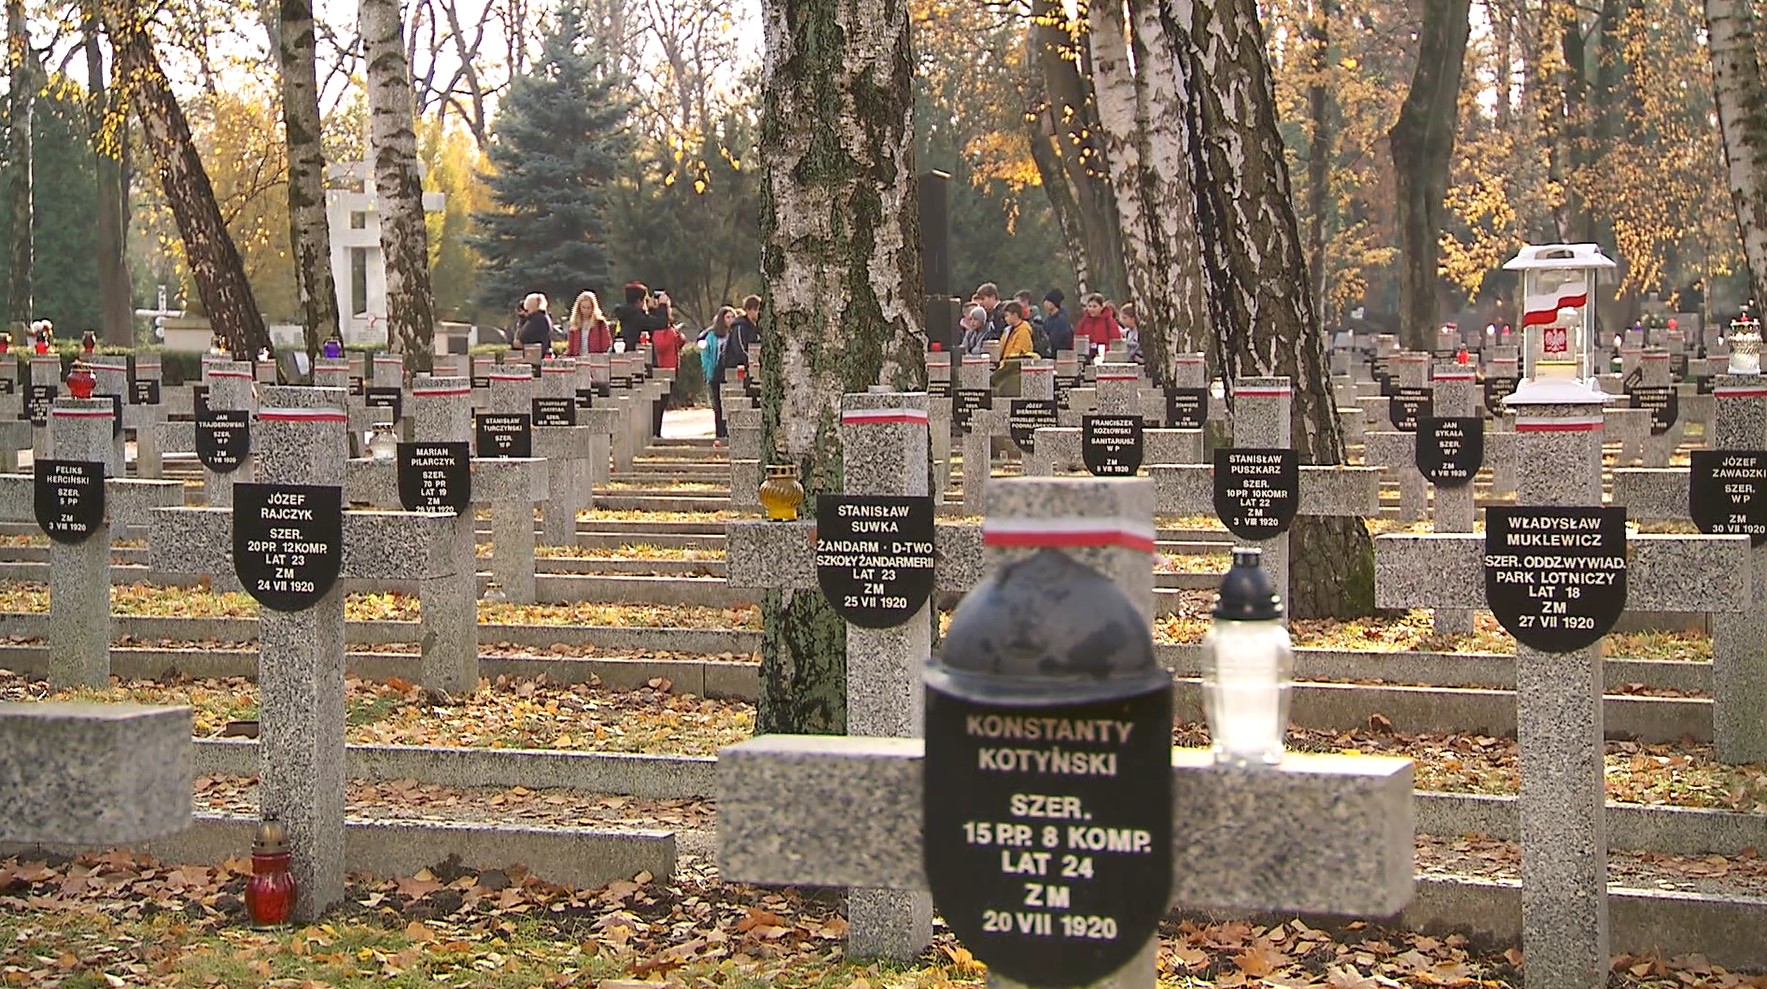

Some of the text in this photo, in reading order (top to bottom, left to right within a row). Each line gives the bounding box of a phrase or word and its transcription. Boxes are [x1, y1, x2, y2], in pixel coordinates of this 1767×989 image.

[483, 424, 523, 432] TURCZYŃSKI
[1093, 427, 1132, 435] KOZŁOWSKI
[416, 448, 449, 456] MARIAN
[411, 458, 455, 466] PILARCZYK
[1229, 454, 1282, 464] STANISŁAW
[1722, 455, 1757, 467] JÓZEF
[55, 465, 83, 474] FELIKS
[422, 471, 446, 479] SZER.
[1114, 465, 1129, 473] 1920
[1231, 465, 1281, 474] PUSZKARZ
[1712, 469, 1766, 478] ZAWADZKI
[46, 475, 90, 484] HERCIŃSKI
[423, 480, 432, 488] 70
[1242, 479, 1270, 488] SZER.
[57, 488, 80, 497] SZER.
[420, 488, 447, 496] LAT 19
[1724, 484, 1756, 493] SZER.
[60, 497, 65, 505] 5
[267, 491, 306, 505] JÓZEF
[1240, 498, 1270, 507] LAT 22
[260, 507, 313, 520] RAJCZYK
[837, 504, 910, 518] STANISŁAW
[48, 521, 54, 530] 3
[70, 523, 87, 532] 1920
[851, 521, 899, 533] SUWKA
[1233, 518, 1240, 526] 3
[1259, 518, 1279, 527] 1920
[1507, 516, 1601, 530] WŁADYSŁAW
[269, 528, 303, 540] SZER.
[1712, 524, 1766, 534] 30 VII 1920
[1506, 533, 1602, 547] MUKLEWICZ
[817, 539, 933, 554] ŻANDARM D-TWO
[265, 553, 305, 566] LAT 23
[816, 553, 934, 568] SZKOŁY ŻANDARMERII
[1485, 555, 1522, 568] SZER.
[852, 568, 896, 581] LAT 23
[1496, 571, 1616, 585] PARK LOTNICZY
[257, 580, 315, 593] 24 VII 1920
[1528, 585, 1581, 599] LAT 18
[844, 596, 907, 609] 25 VII 1920
[1518, 615, 1595, 629] 27 VII 1920
[966, 715, 1135, 744] KONSTANTY
[978, 746, 1117, 776] KOTYŃSKI
[1010, 794, 1092, 820] SZER.
[1041, 825, 1059, 848] 8
[1067, 826, 1152, 853] KOMP.
[1001, 850, 1094, 879] LAT 24
[982, 910, 1117, 940] 20 VII 1920
